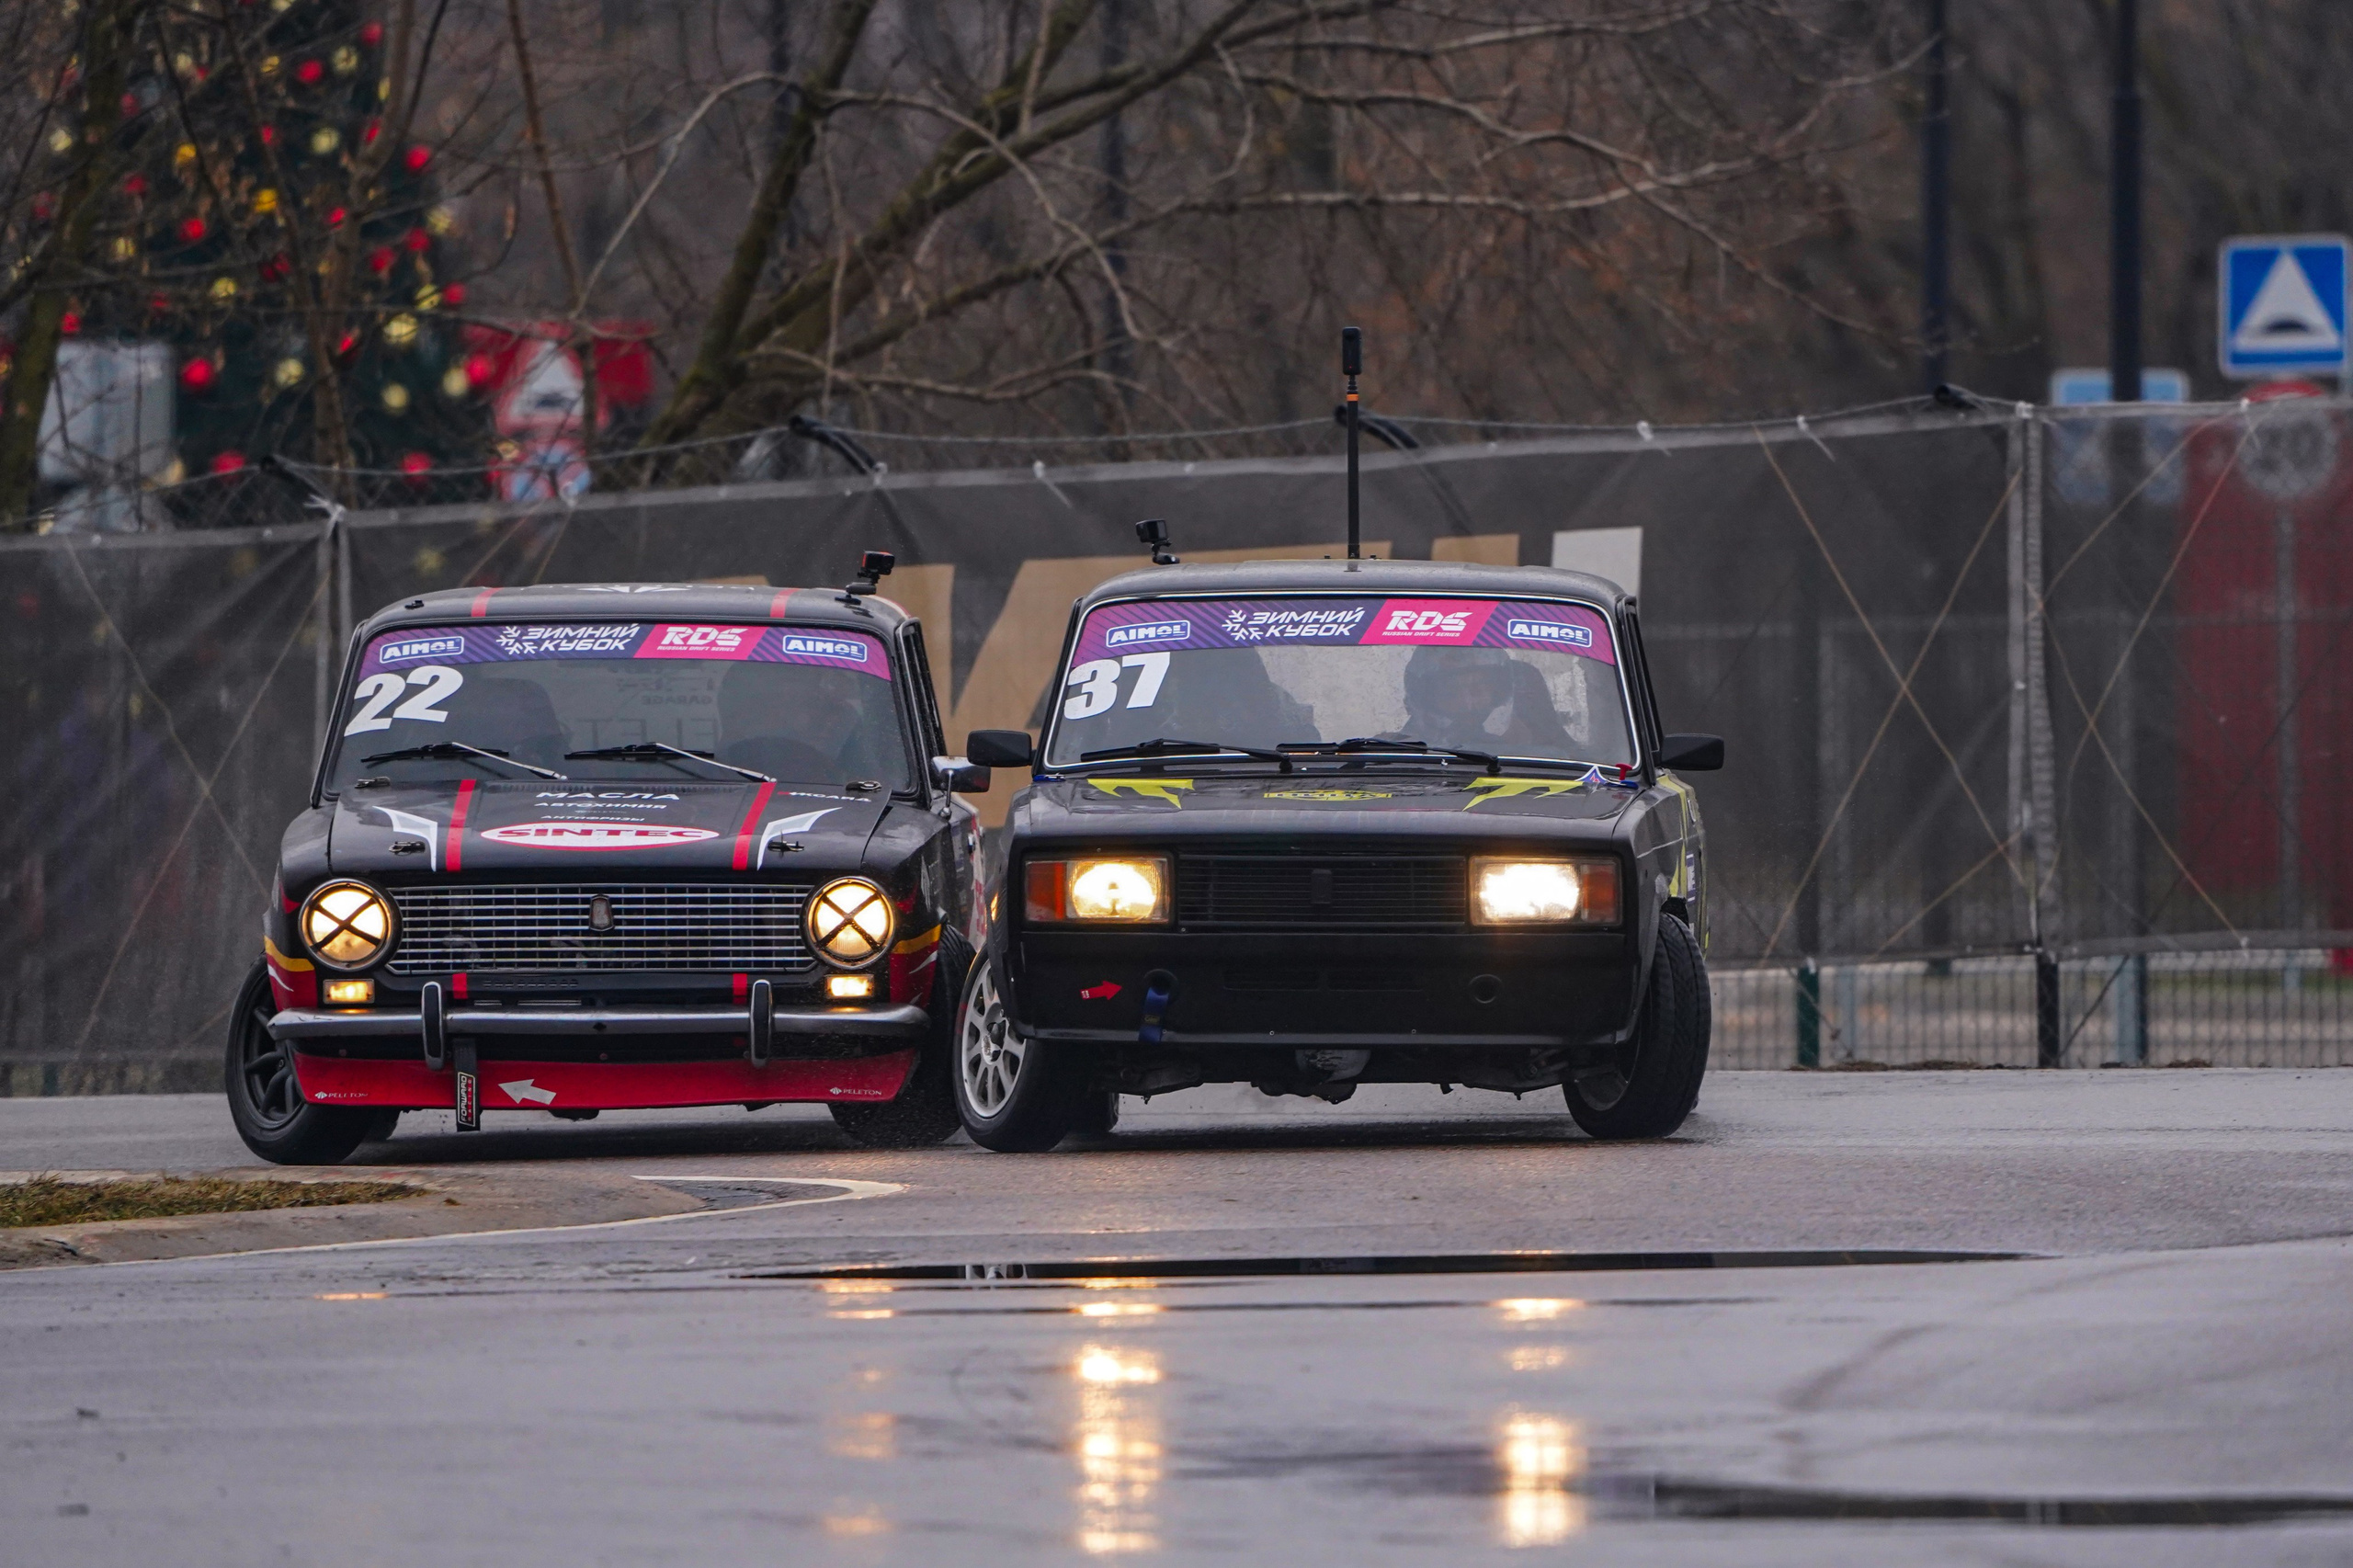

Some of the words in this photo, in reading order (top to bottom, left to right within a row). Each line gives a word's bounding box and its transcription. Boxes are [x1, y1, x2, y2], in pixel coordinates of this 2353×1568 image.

[1247, 607, 1365, 625] ЗИМНИЙ
[1385, 610, 1473, 631] RDS
[522, 623, 641, 640] ЗИМНИЙ
[661, 626, 749, 647] RDS
[1109, 624, 1186, 643] AIMOL
[1265, 623, 1357, 637] КУБОК
[1512, 623, 1587, 642] AIMOL
[383, 641, 460, 659] AIMOL
[540, 639, 632, 652] КУБОК
[786, 639, 863, 658] AIMOL
[1063, 652, 1171, 720] 37
[344, 665, 463, 737] 22
[536, 792, 680, 801] МАСЛА
[497, 828, 703, 838] SINTEC
